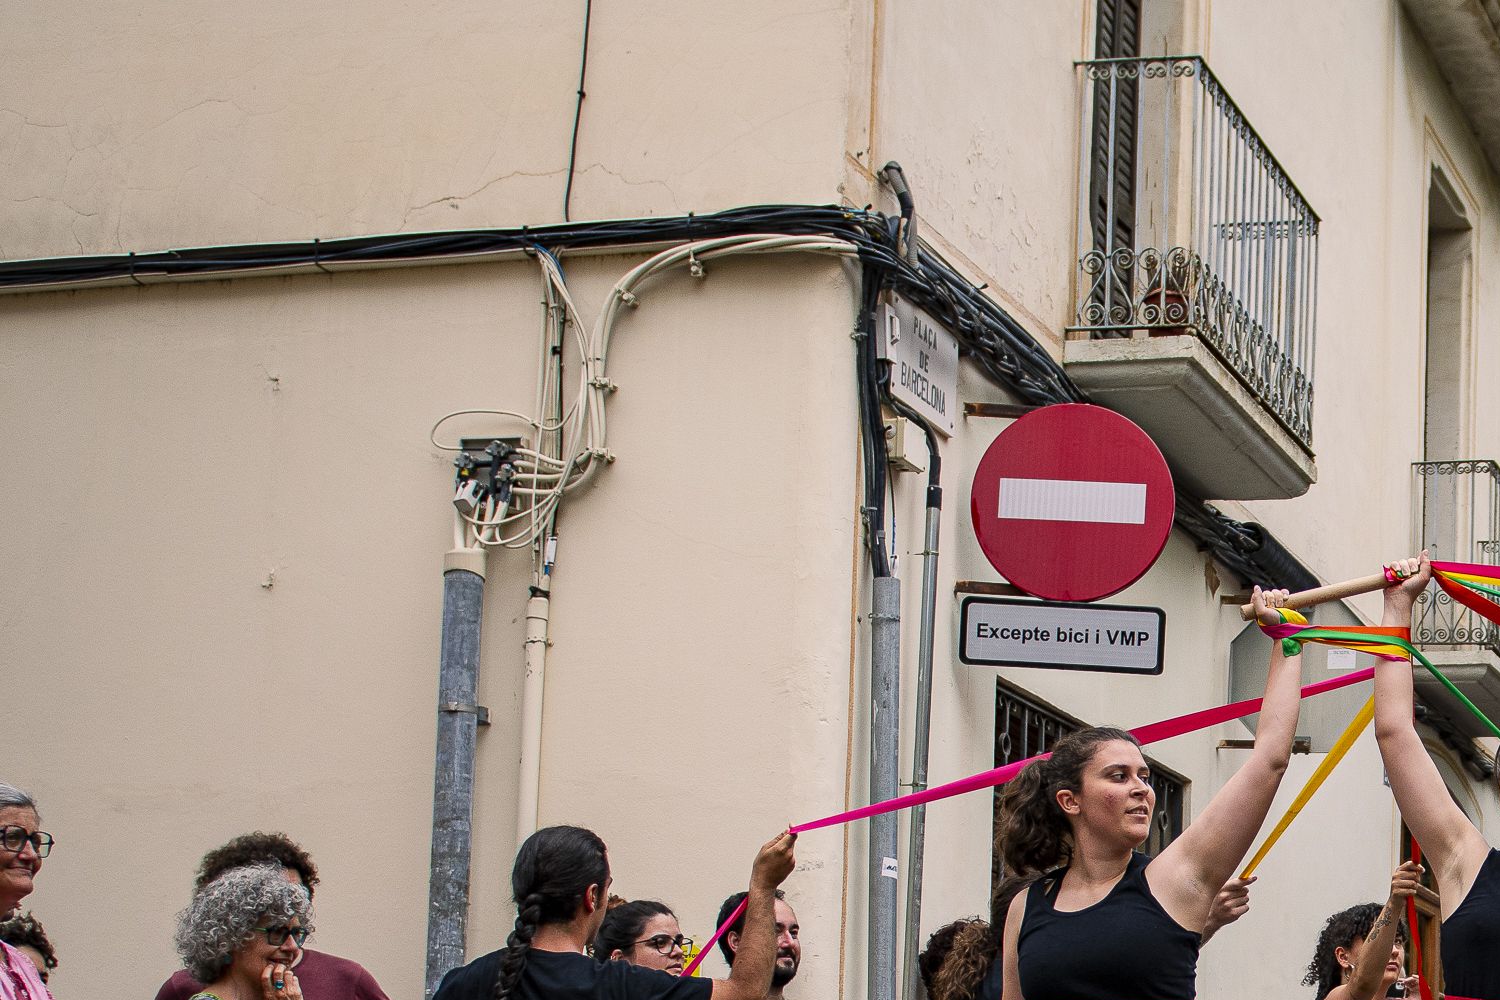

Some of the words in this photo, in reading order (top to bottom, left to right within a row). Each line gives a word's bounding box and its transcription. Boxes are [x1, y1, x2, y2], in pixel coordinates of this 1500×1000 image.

[913, 315, 938, 351] PLAÇA
[919, 349, 930, 374] DE
[900, 361, 946, 417] BARCELONA
[976, 622, 1050, 644] Excepte
[1056, 626, 1089, 644] bici
[1095, 628, 1100, 644] i
[1106, 629, 1150, 647] VMP
